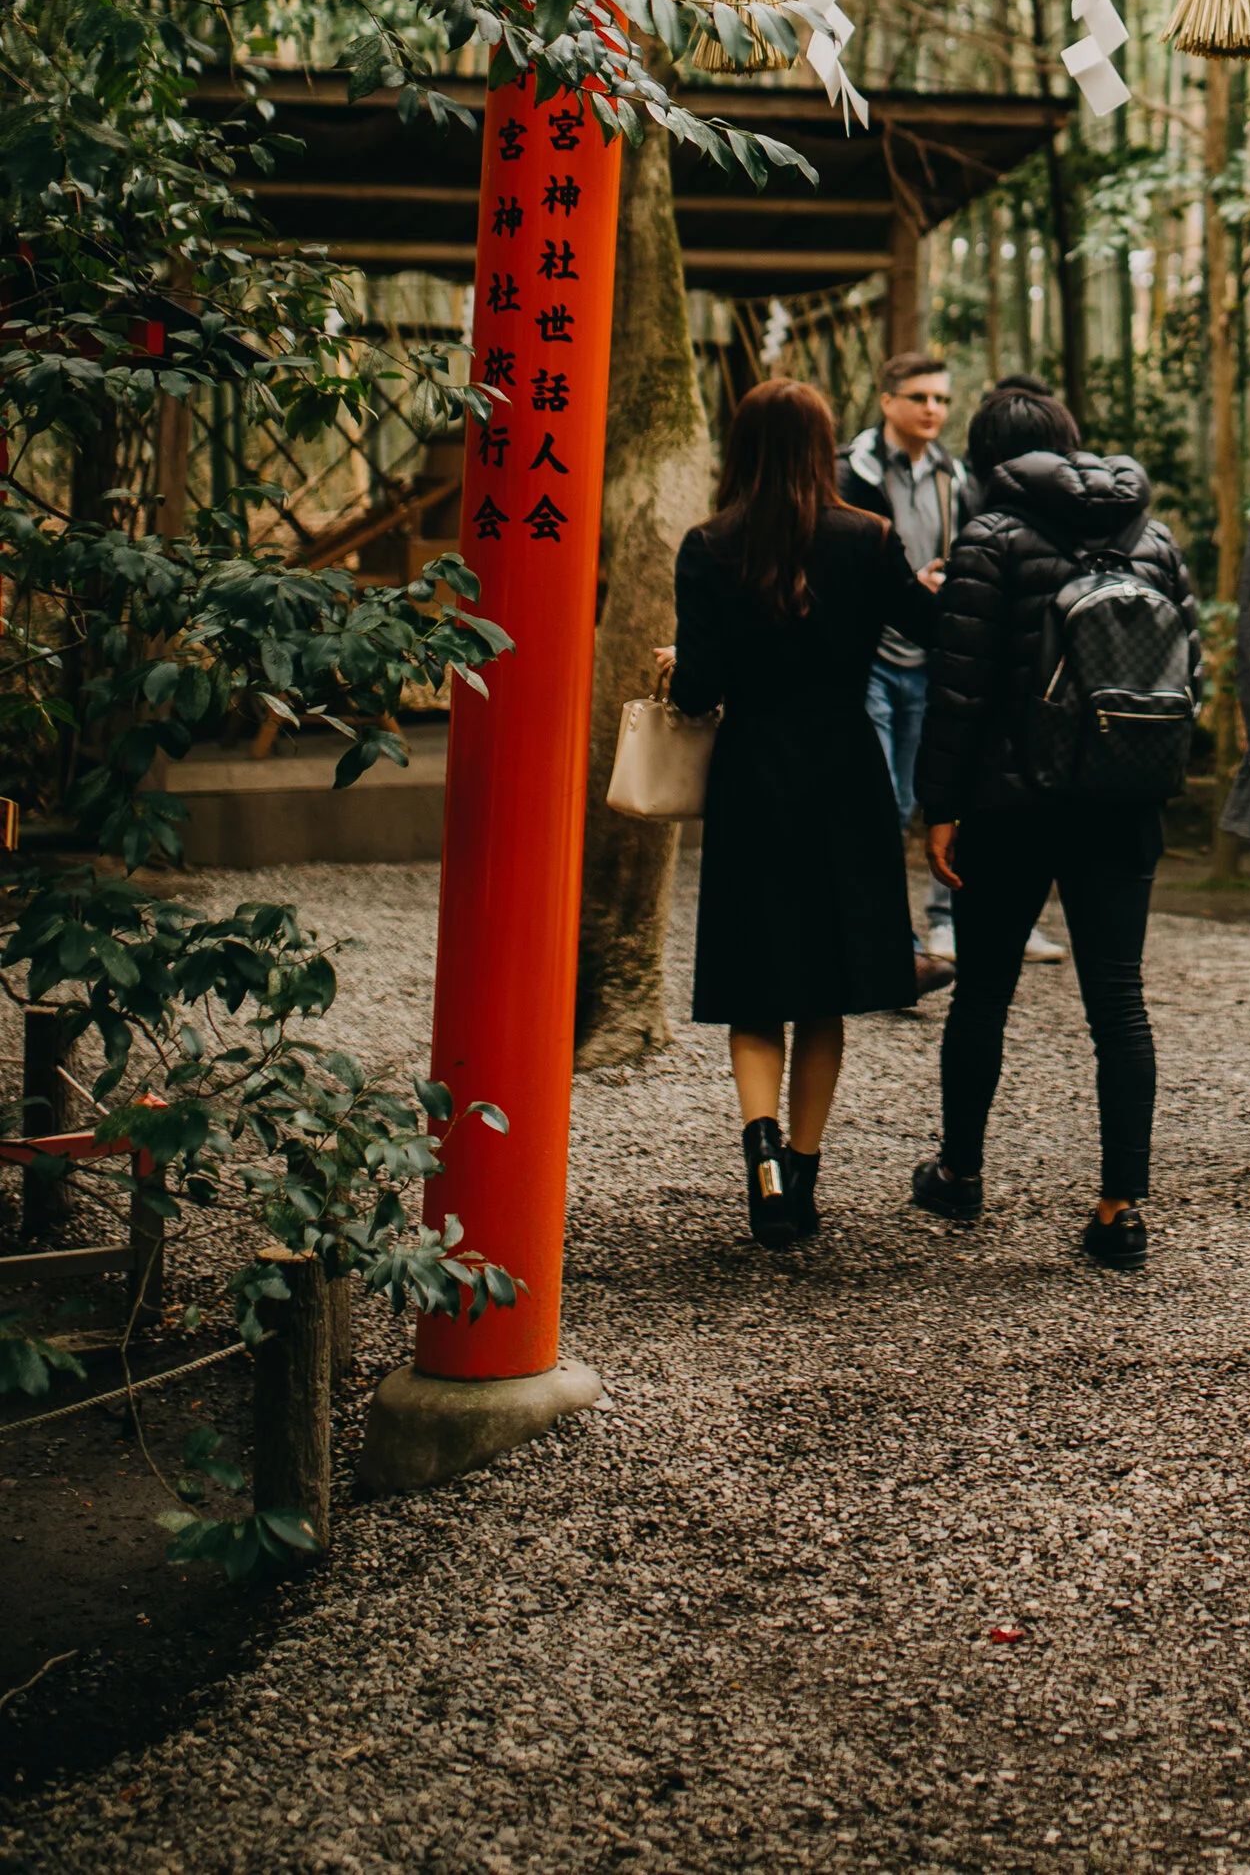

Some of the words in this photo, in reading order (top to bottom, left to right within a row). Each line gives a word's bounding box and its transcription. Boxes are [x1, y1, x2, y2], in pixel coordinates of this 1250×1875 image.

[472, 60, 534, 541] 宮神社旅行会
